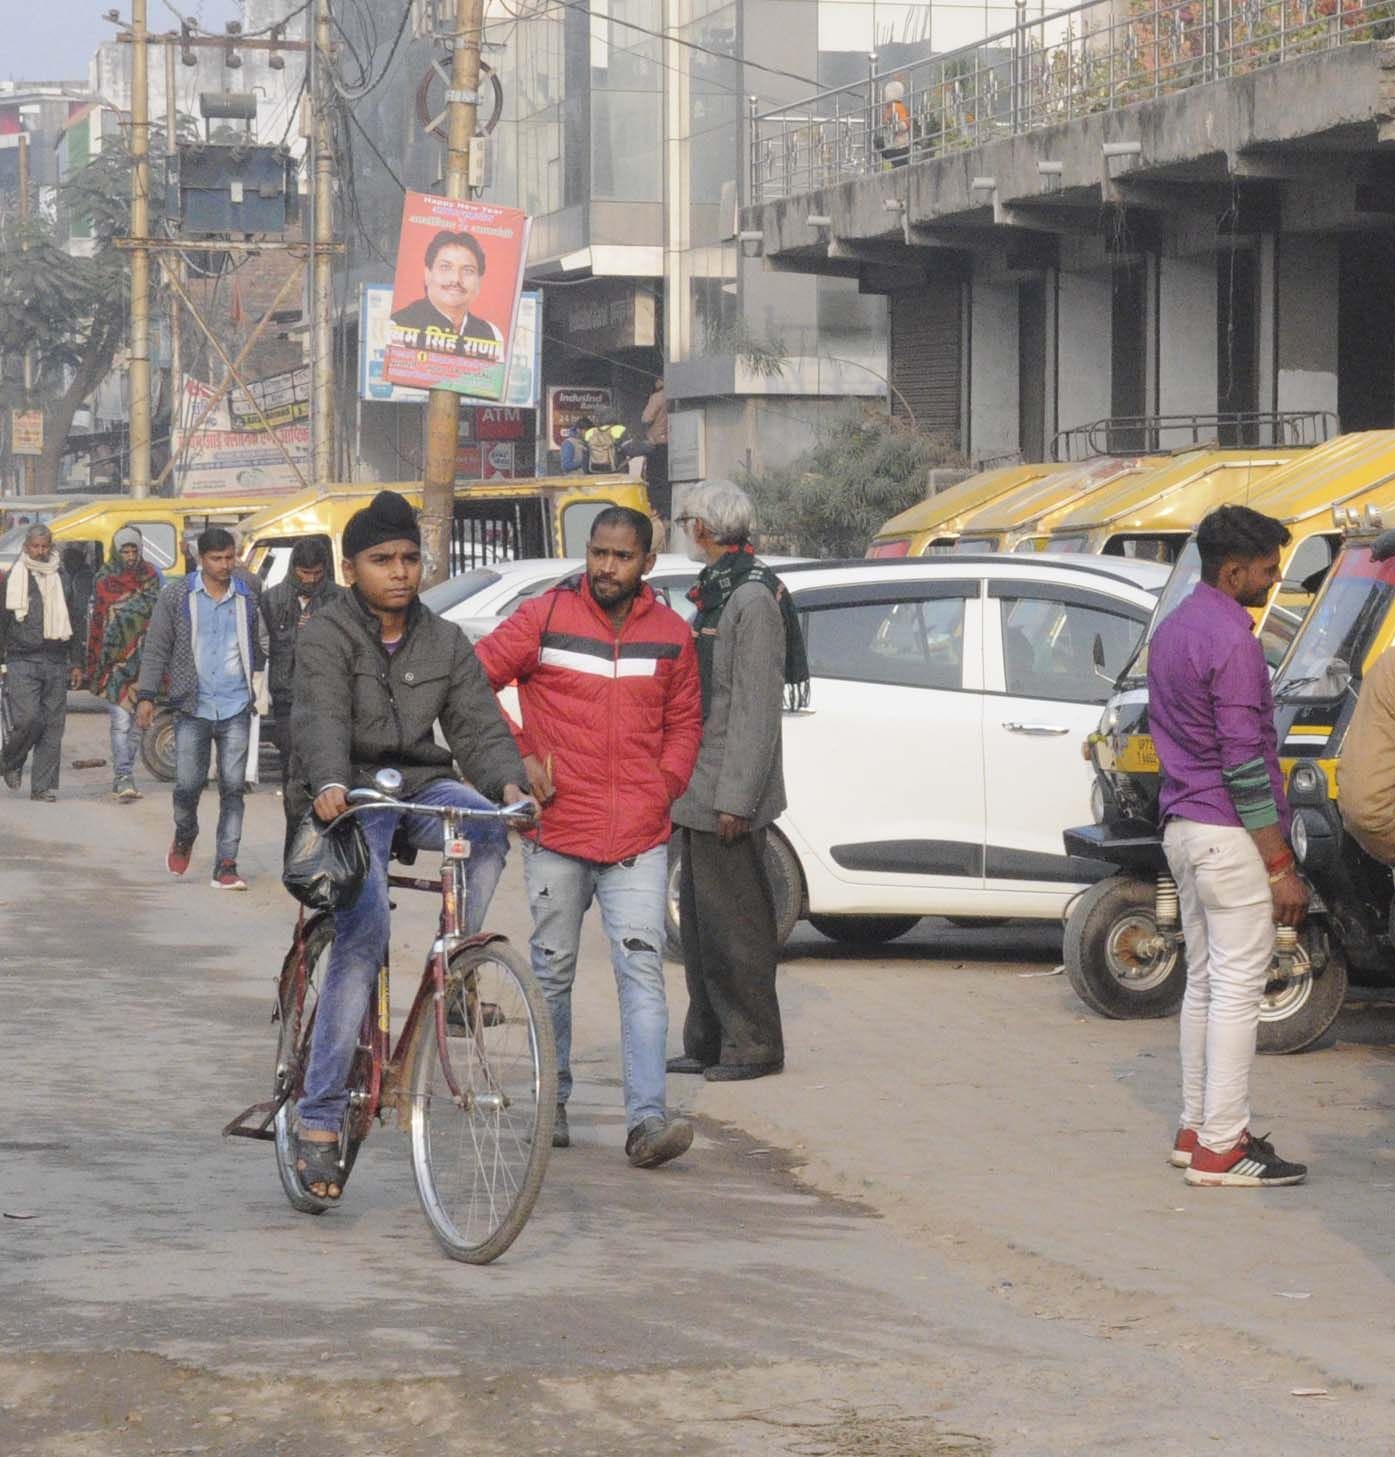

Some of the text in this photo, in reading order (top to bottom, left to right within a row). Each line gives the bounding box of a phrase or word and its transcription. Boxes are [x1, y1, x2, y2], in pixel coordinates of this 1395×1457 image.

[457, 202, 479, 211] New
[481, 206, 503, 215] Year
[481, 407, 521, 422] ATM
